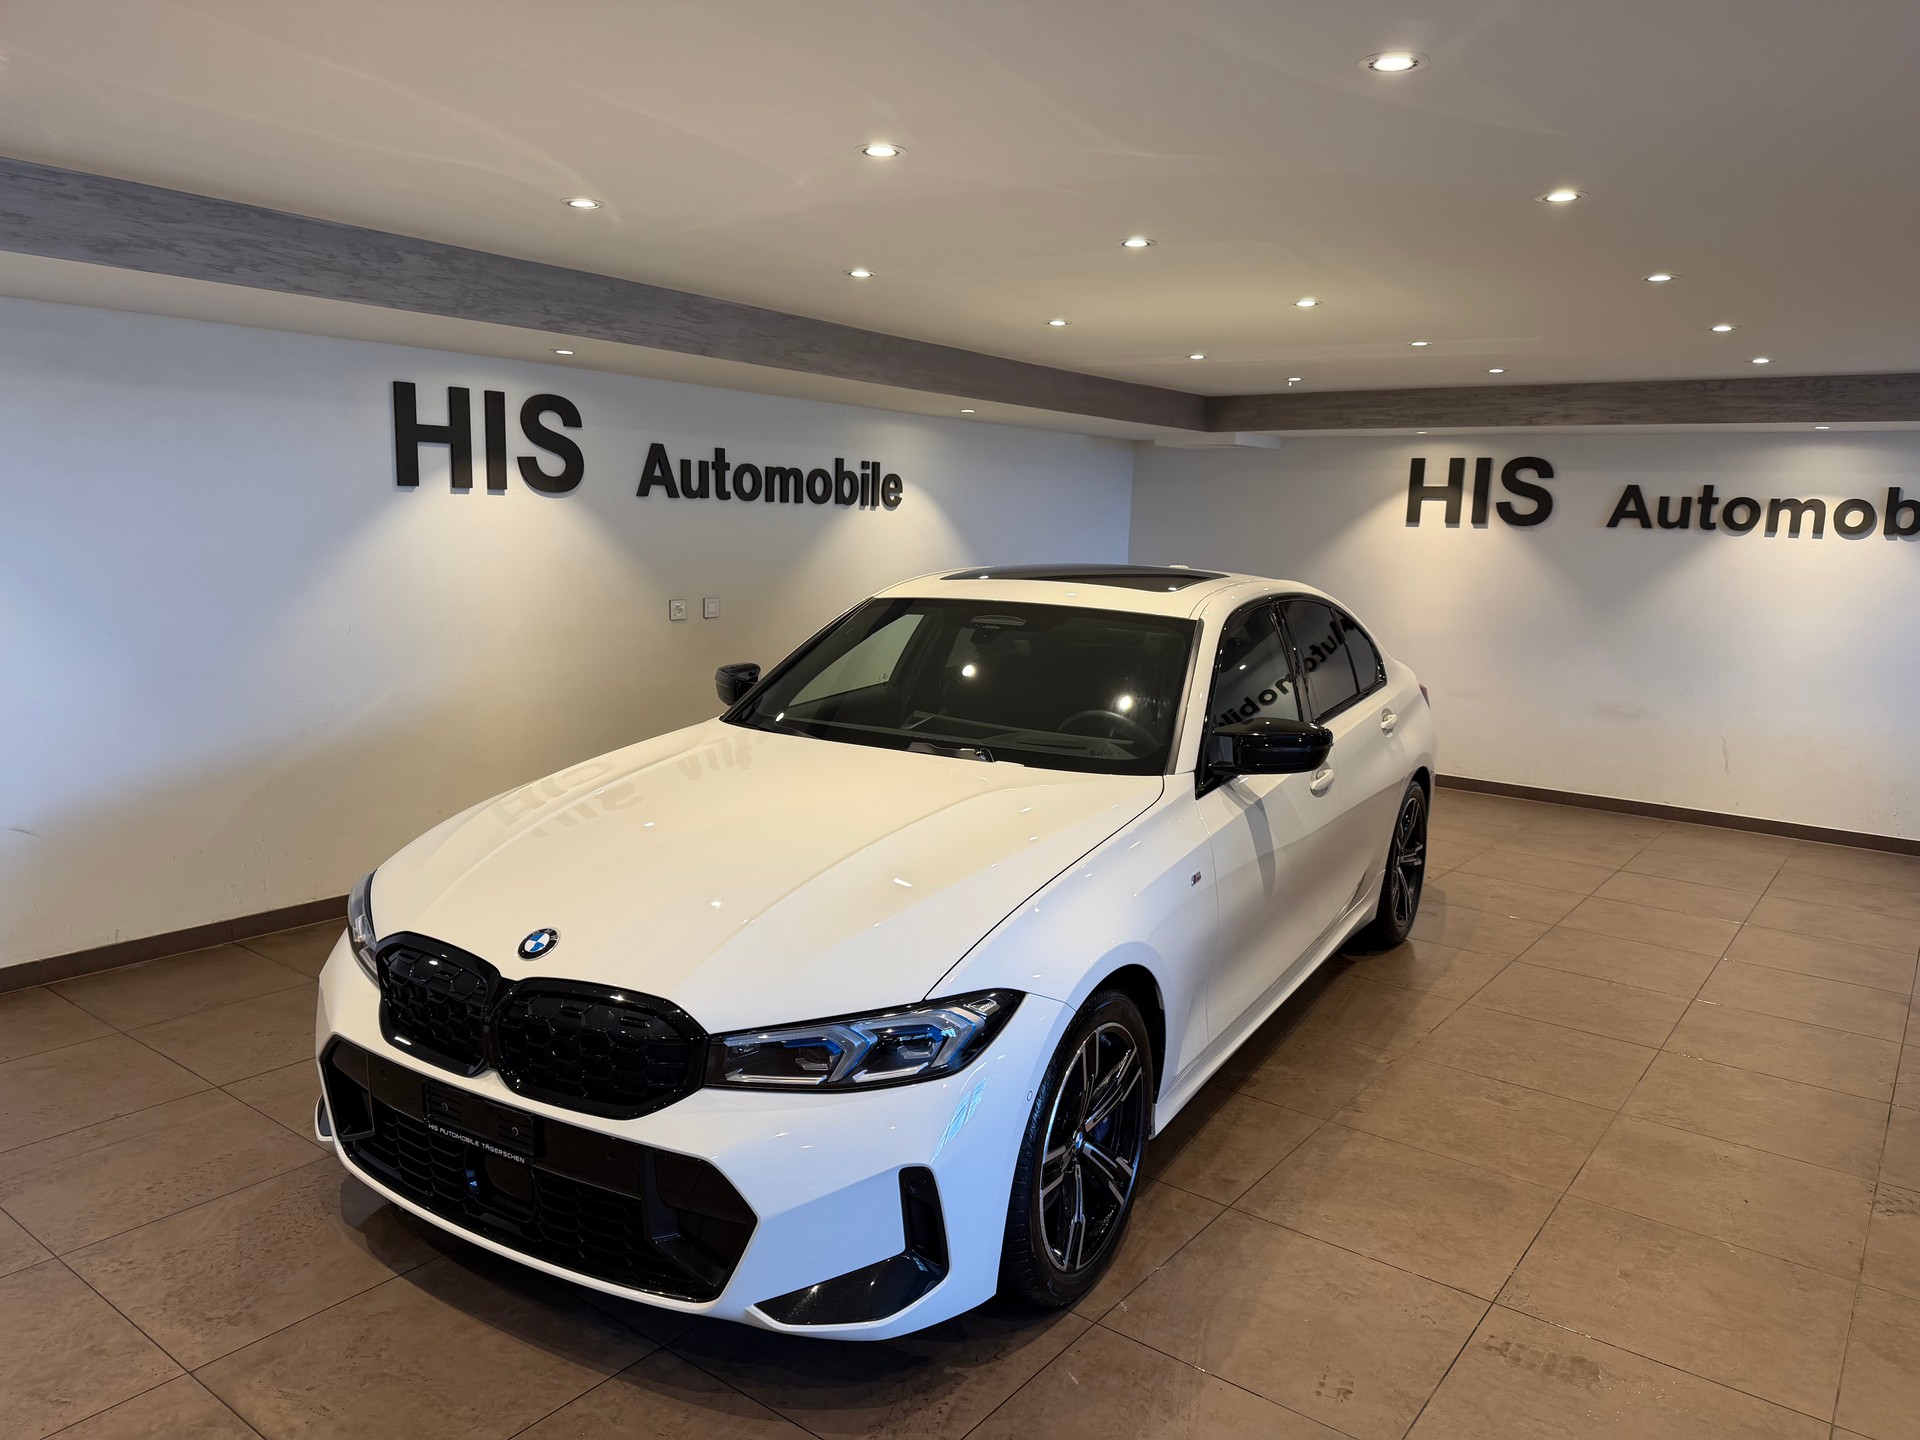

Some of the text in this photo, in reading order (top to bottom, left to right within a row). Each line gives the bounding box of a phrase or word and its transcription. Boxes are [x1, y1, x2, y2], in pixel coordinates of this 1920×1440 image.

[392, 380, 904, 510] HIS Automobile
[1405, 456, 1920, 537] HIS Automob
[428, 1123, 438, 1132] HIS
[439, 1127, 480, 1147] AUTOMOBILE
